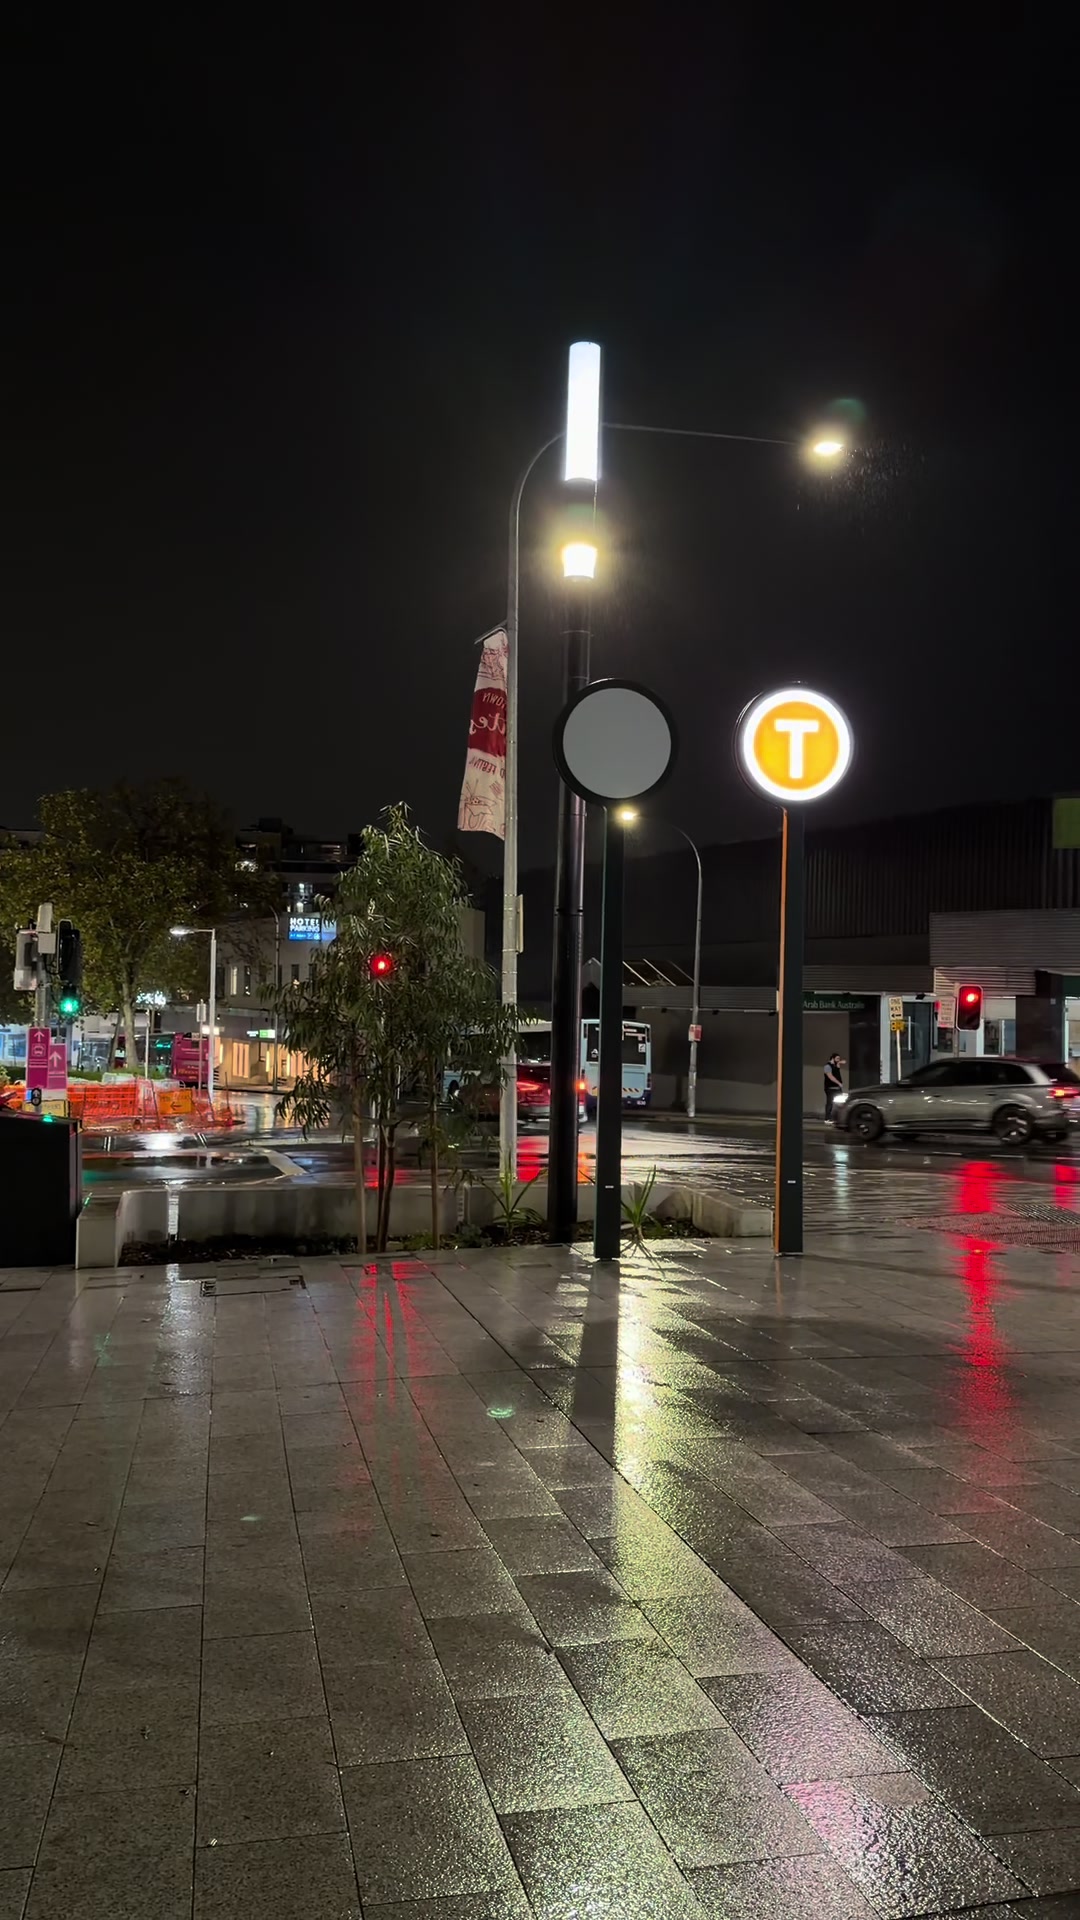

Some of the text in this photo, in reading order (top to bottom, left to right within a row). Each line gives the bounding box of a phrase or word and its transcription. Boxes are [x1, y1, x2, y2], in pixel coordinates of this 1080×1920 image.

[774, 719, 820, 779] T
[290, 917, 320, 926] HOTEL
[803, 999, 819, 1009] Arab
[820, 999, 836, 1009] Bank
